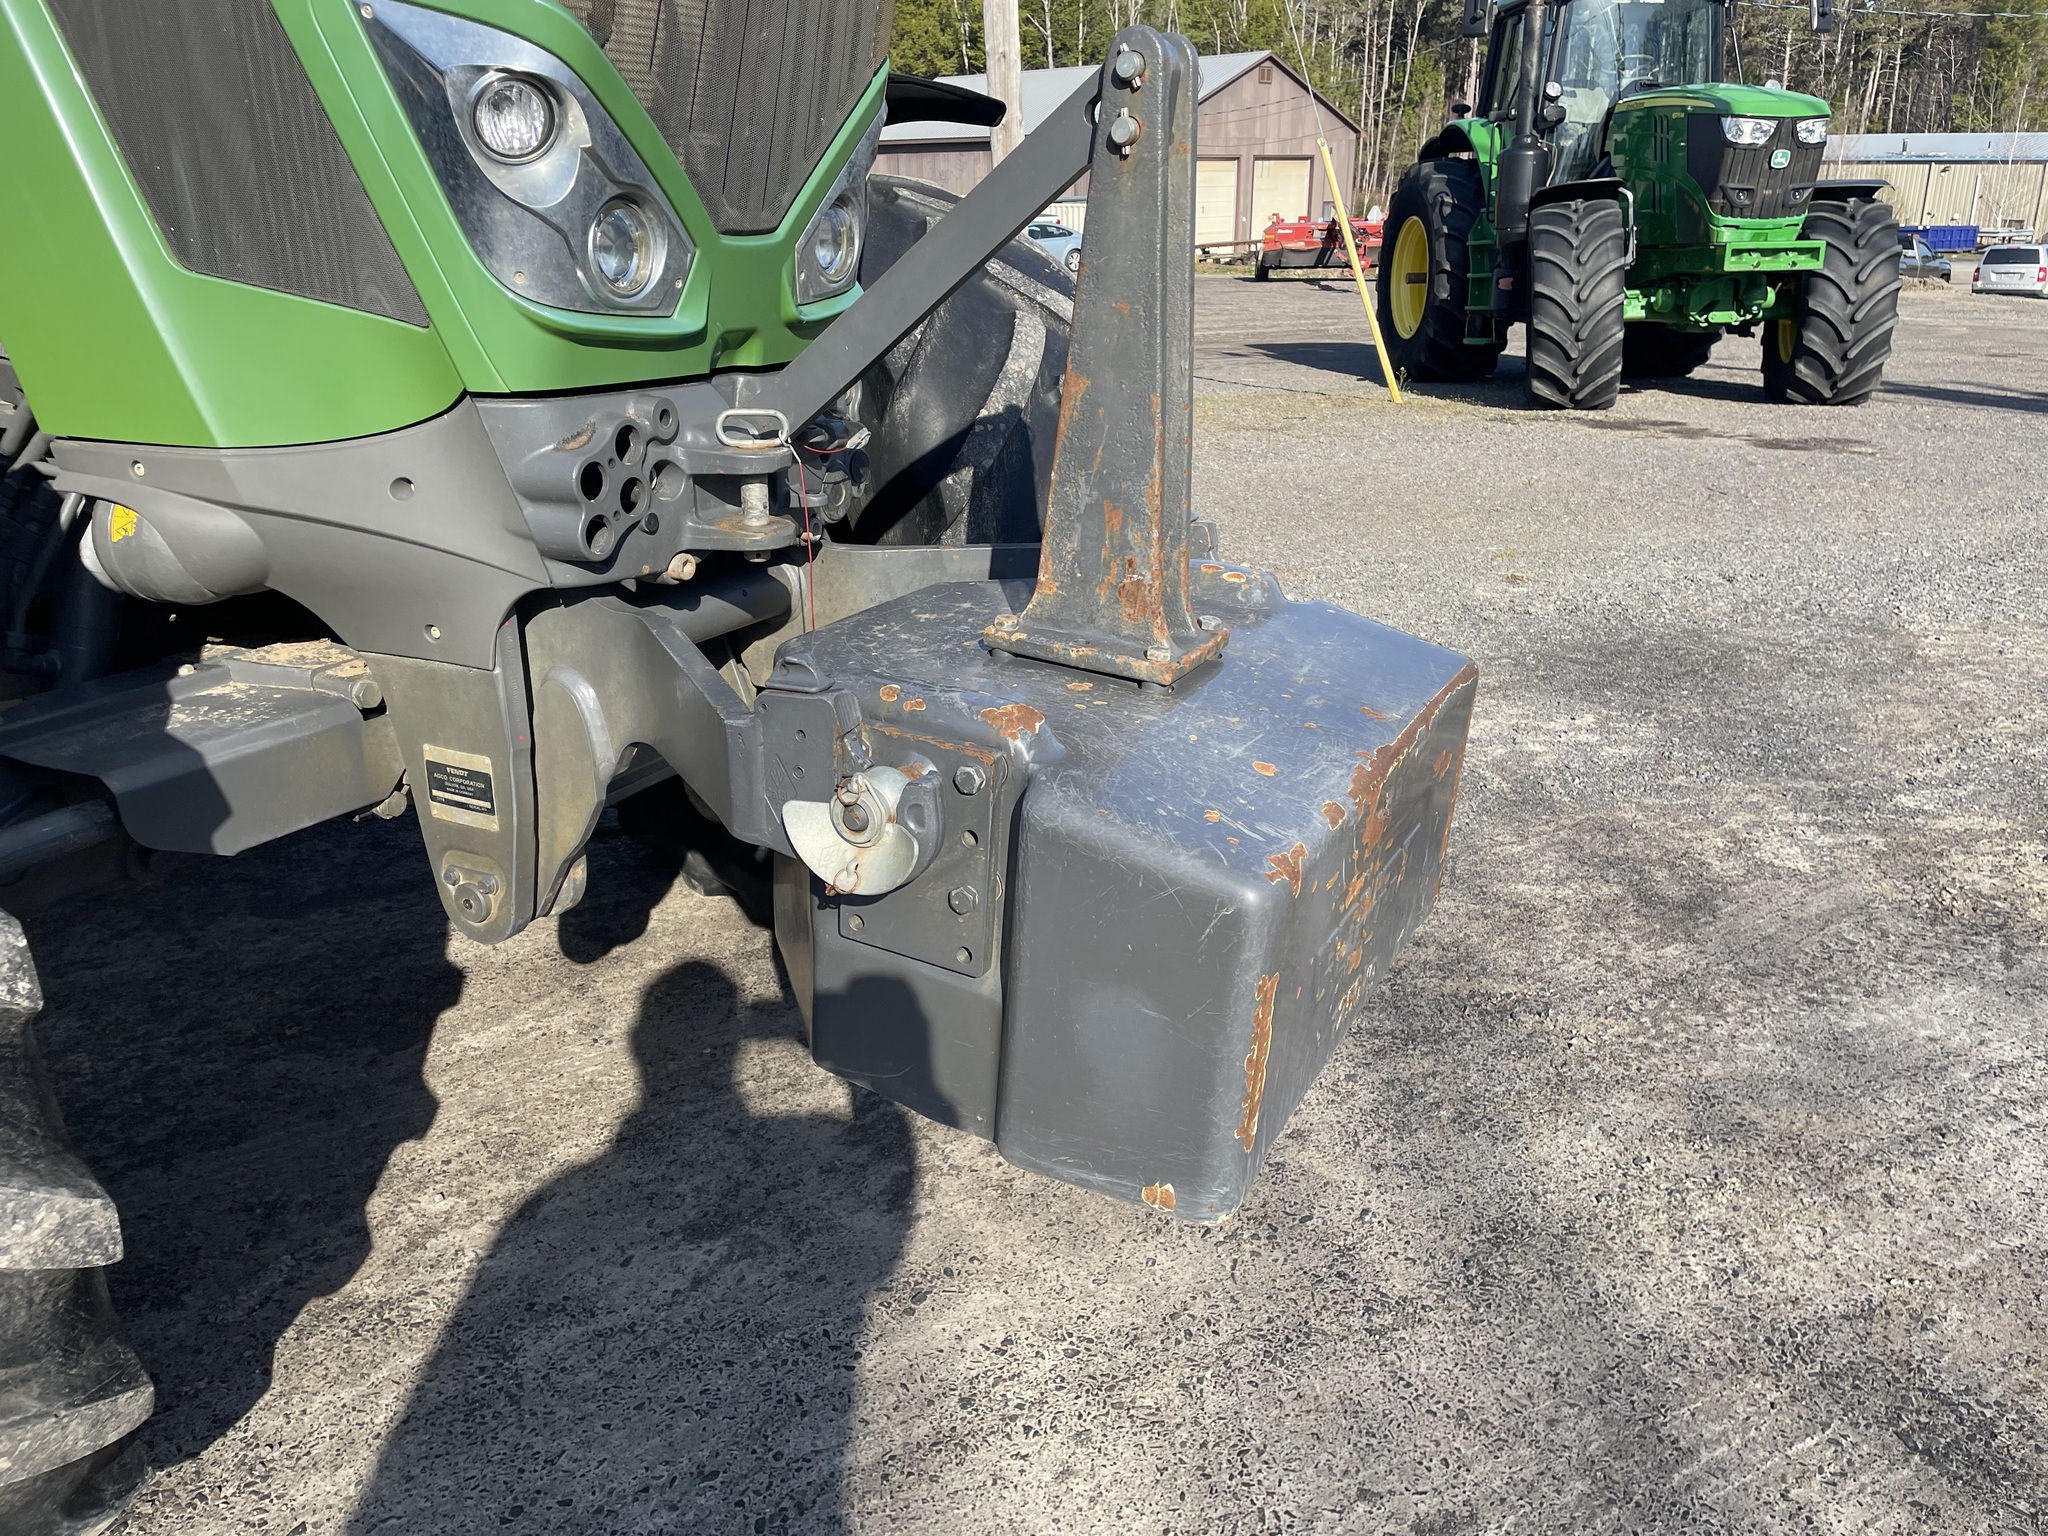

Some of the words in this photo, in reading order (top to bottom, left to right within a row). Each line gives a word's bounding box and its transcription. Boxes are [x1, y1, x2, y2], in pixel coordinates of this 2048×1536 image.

[1200, 205, 1205, 214] 1
[446, 767, 469, 776] FENDT
[449, 776, 485, 789] CORPORATION
